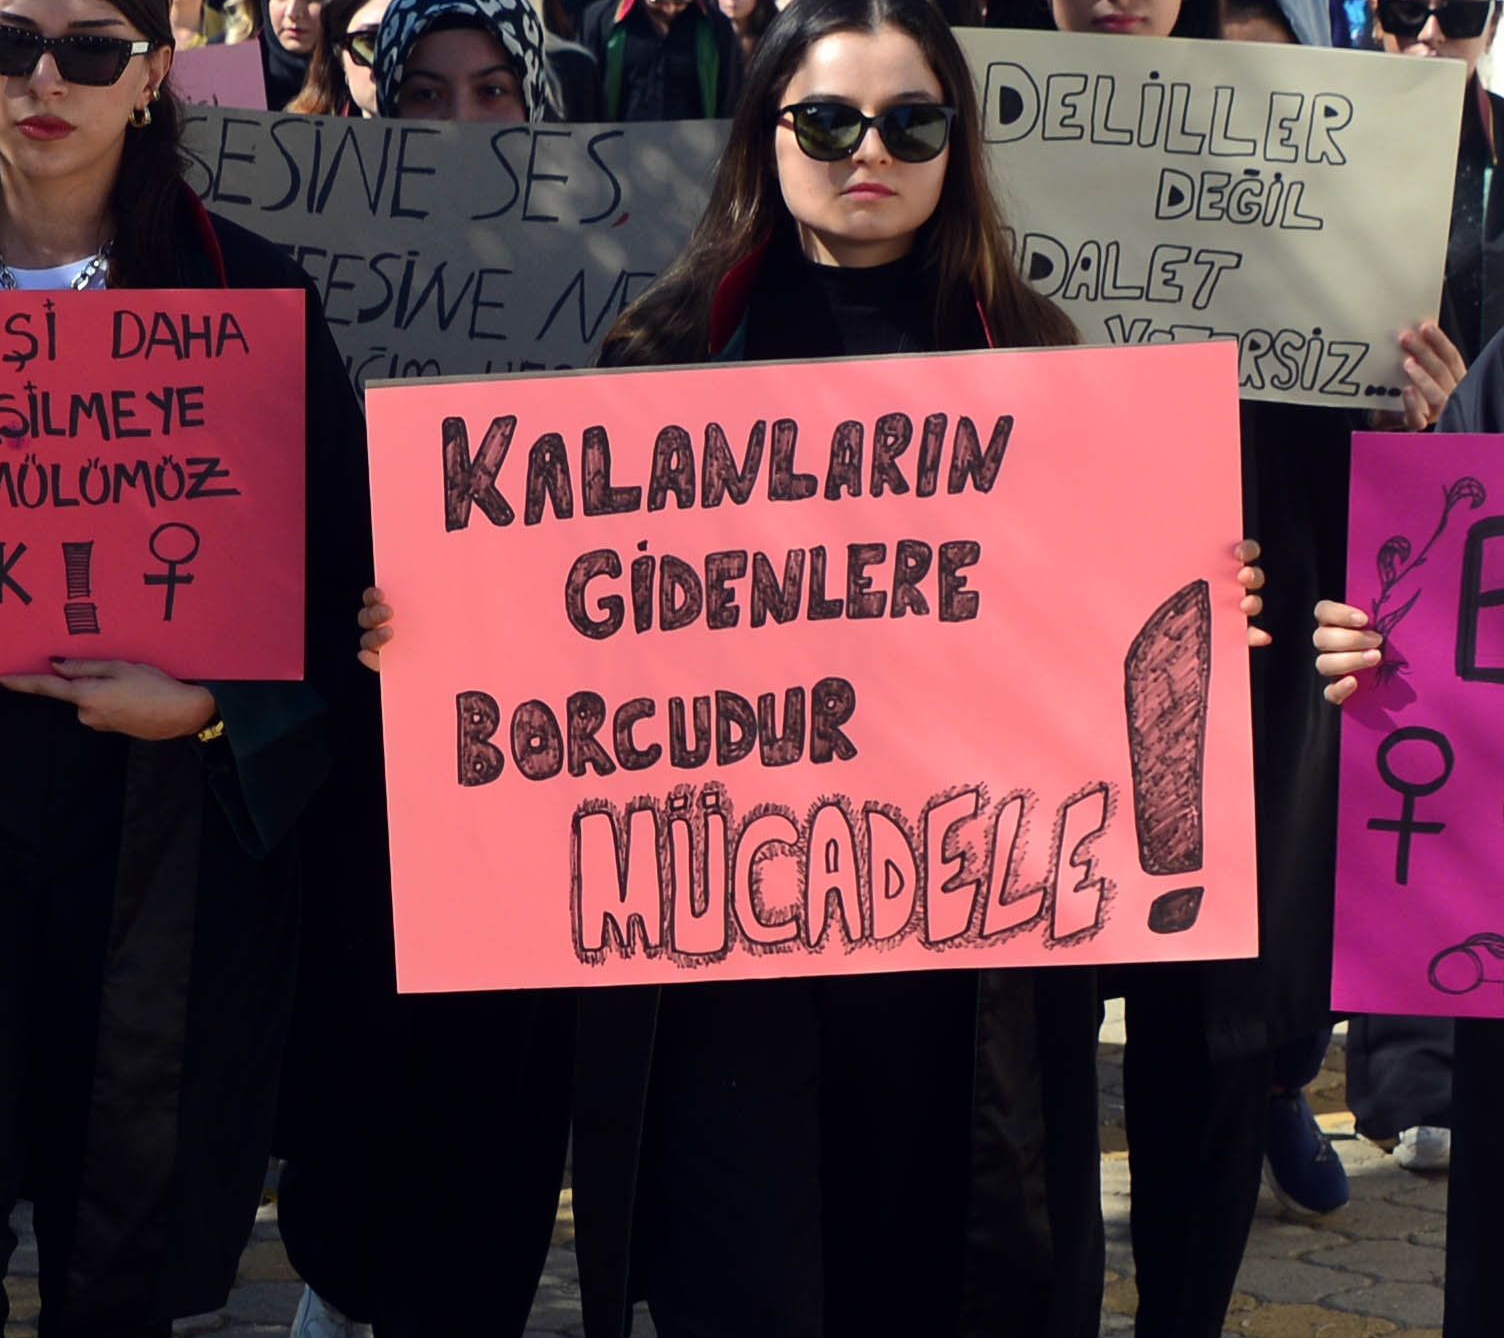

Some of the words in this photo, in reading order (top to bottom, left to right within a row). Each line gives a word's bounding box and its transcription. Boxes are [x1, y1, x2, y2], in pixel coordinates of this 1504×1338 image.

[982, 60, 1354, 166] DELİLLER
[1154, 167, 1324, 230] DEĞİL
[1000, 225, 1243, 310] DALET
[110, 308, 251, 361] DAHA
[440, 412, 1016, 533] KALANLARIN
[564, 537, 983, 641] GİDENLERE
[455, 676, 859, 787] BORCUDUR
